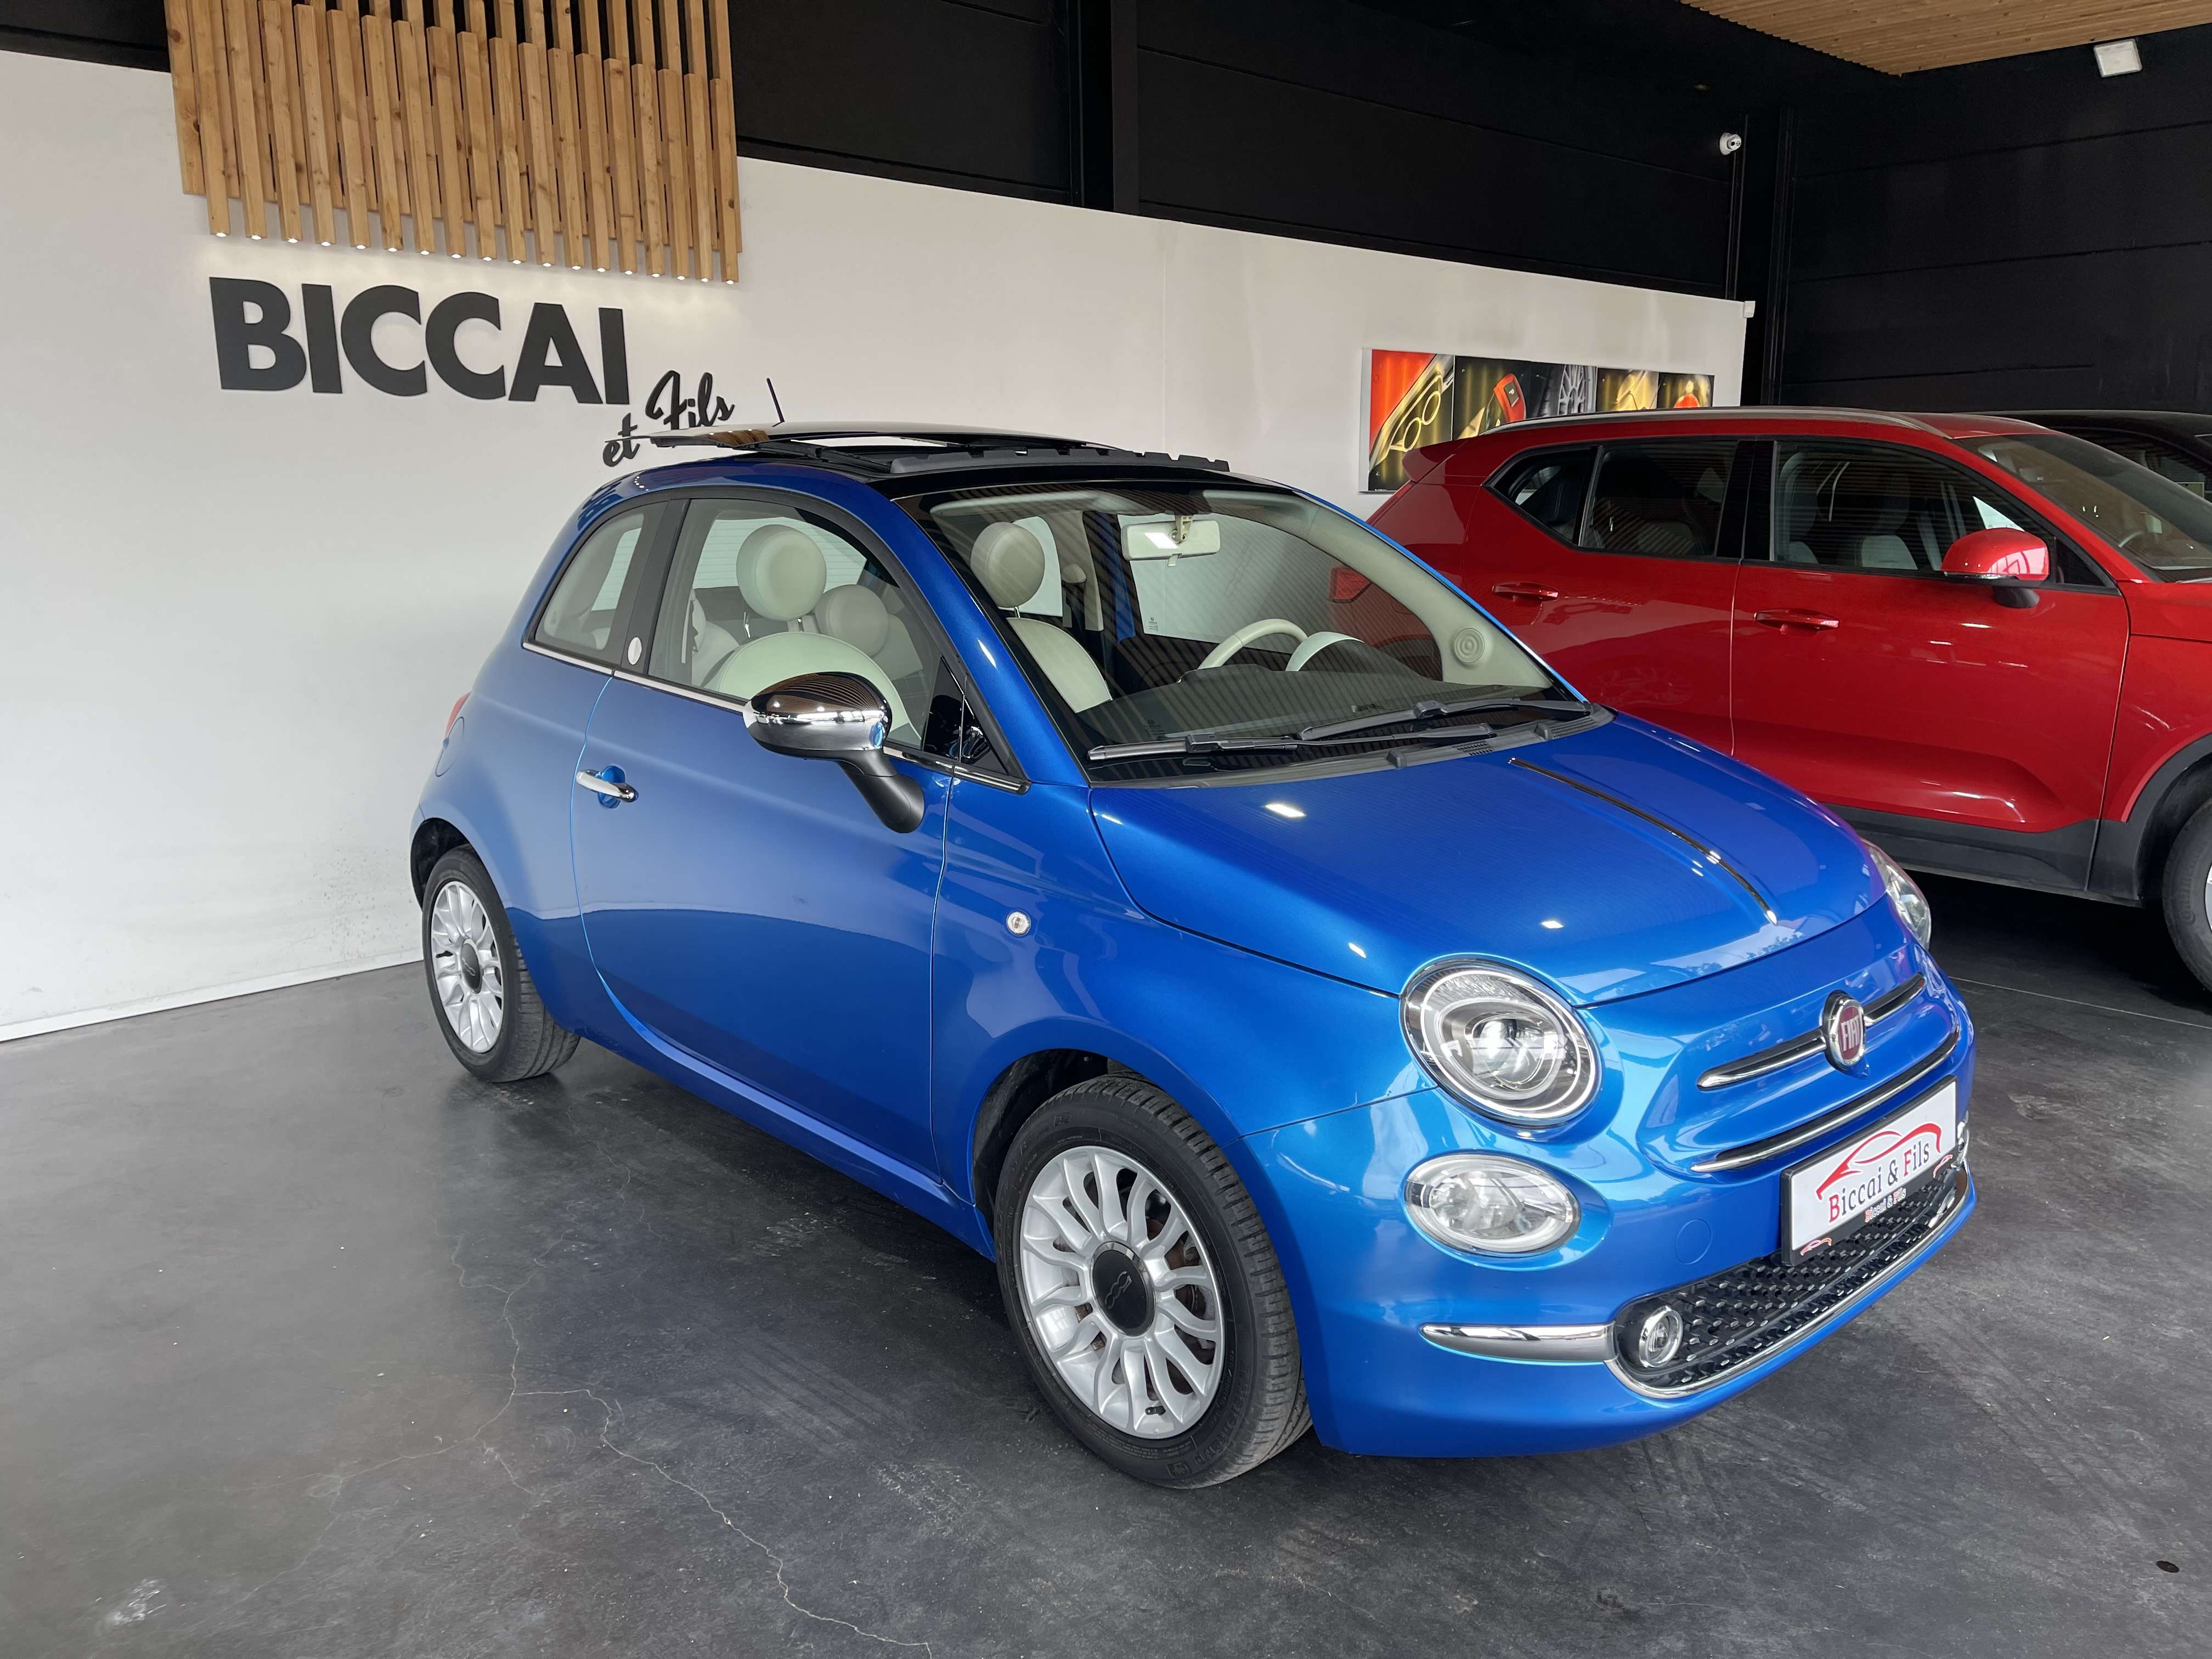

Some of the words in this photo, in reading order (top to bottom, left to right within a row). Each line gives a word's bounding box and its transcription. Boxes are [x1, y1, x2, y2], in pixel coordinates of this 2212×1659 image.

[209, 277, 630, 405] BICCAI
[603, 413, 640, 467] et
[645, 370, 735, 430] Fils
[1841, 1014, 1860, 1052] FIAT
[1829, 1166, 1882, 1223] Biccai
[1888, 1159, 1898, 1186] &
[1904, 1141, 1929, 1177] Fils
